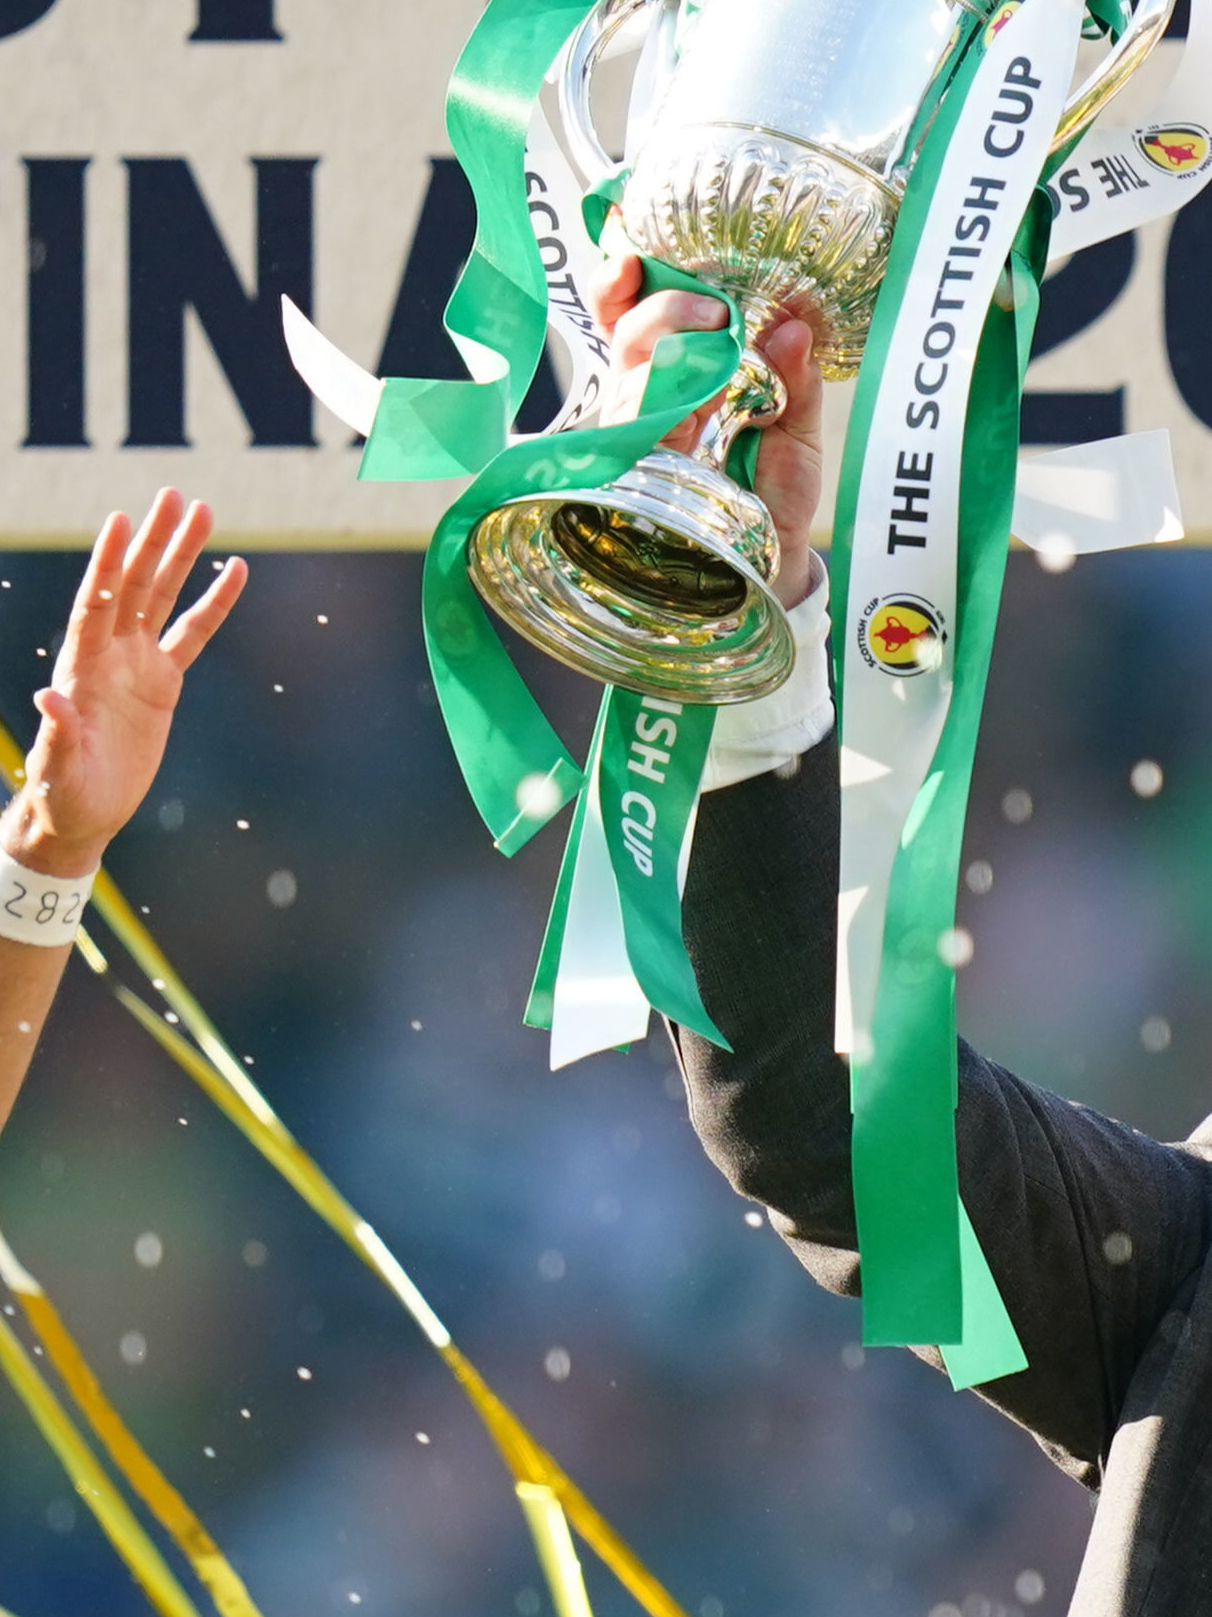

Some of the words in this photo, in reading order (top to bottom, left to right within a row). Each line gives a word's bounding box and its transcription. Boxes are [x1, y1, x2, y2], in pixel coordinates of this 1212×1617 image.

[983, 56, 1042, 158] CUP
[1090, 154, 1150, 199] THE
[21, 156, 625, 447] INA
[906, 176, 1007, 430] SCOTTISH
[887, 450, 934, 555] THE
[858, 618, 877, 668] SCOTTISH
[863, 597, 880, 617] CUP
[621, 791, 654, 877] CUP
[4, 881, 81, 925] 282
